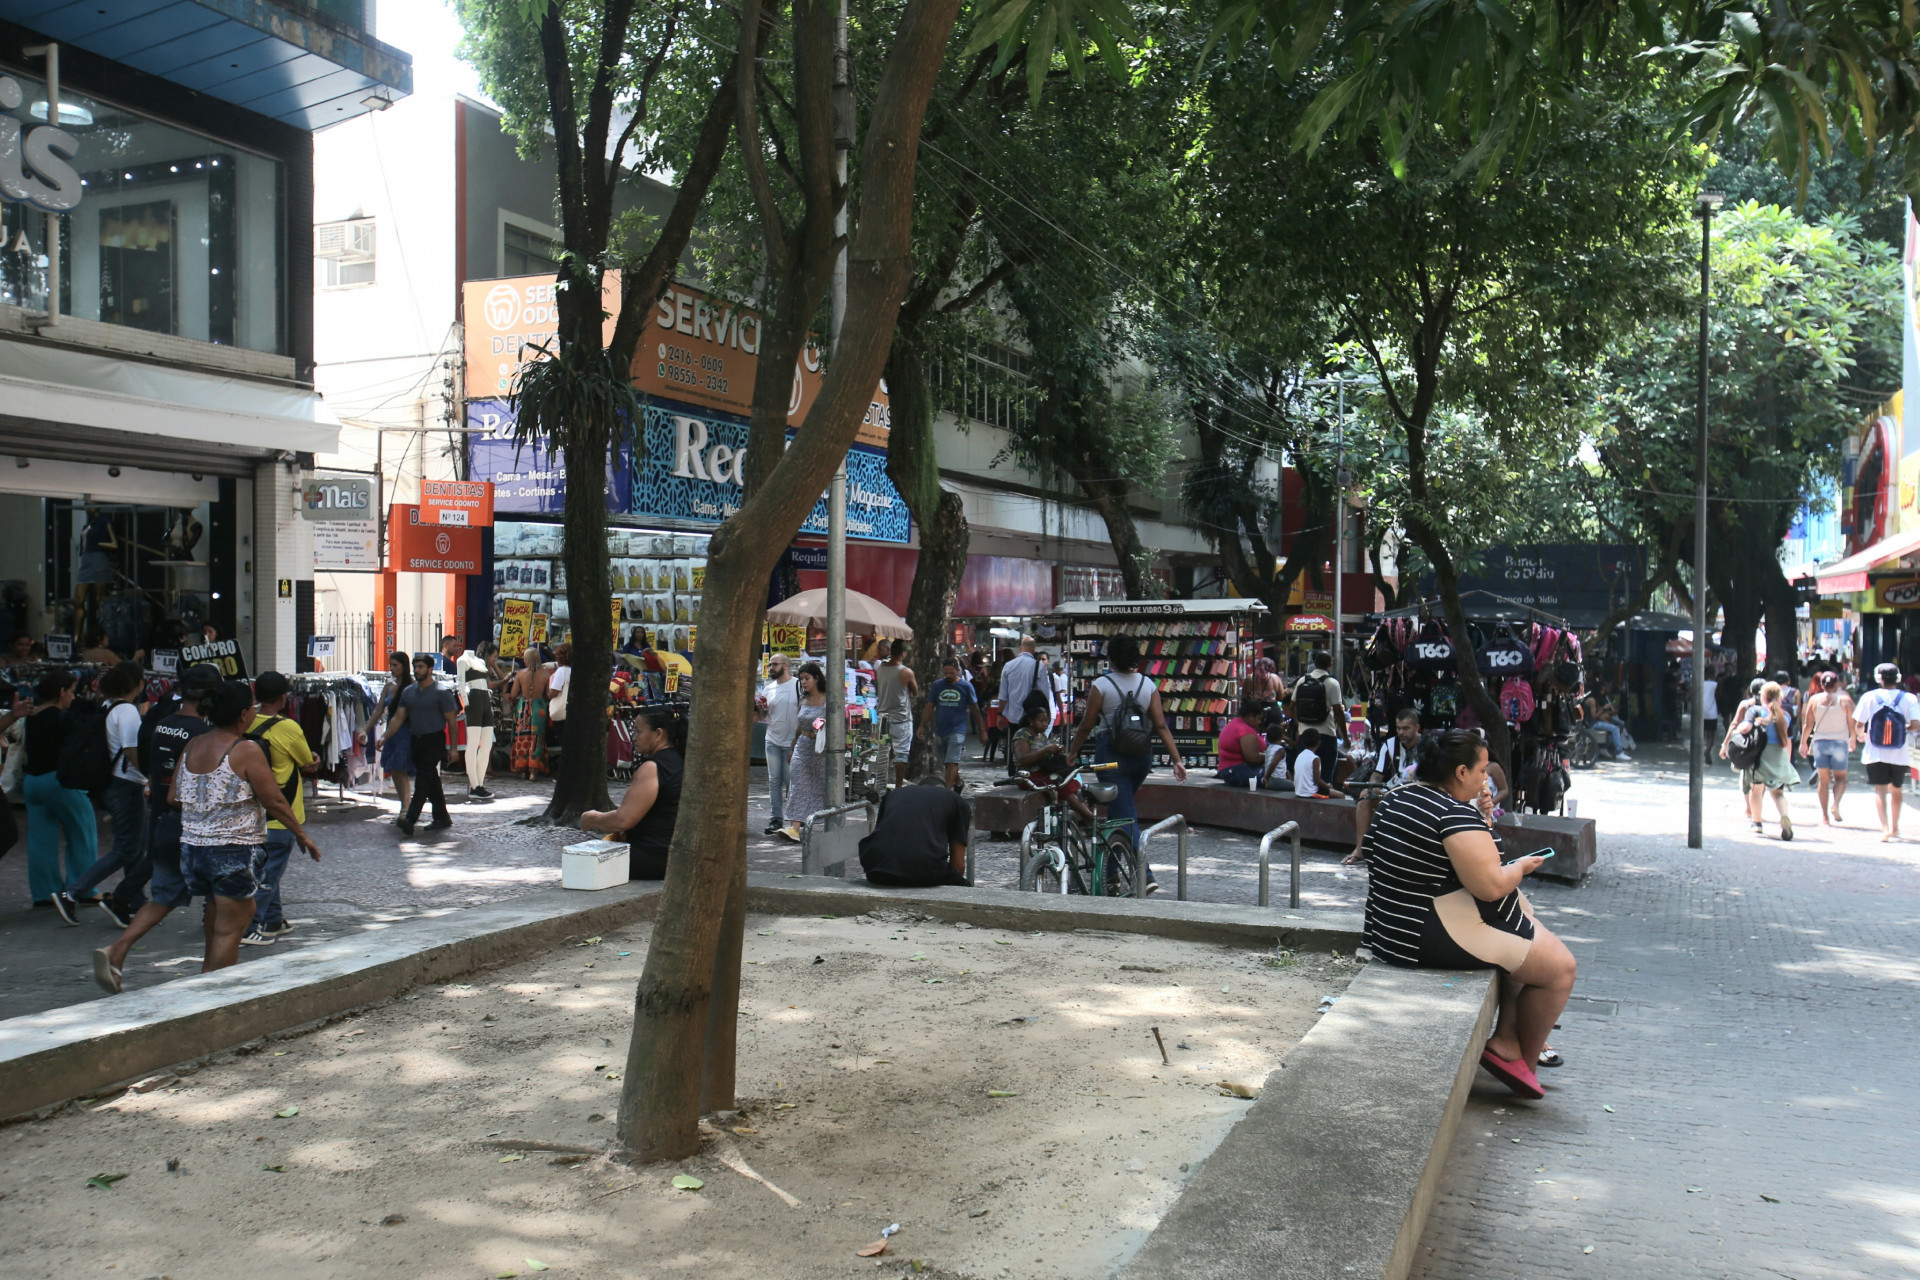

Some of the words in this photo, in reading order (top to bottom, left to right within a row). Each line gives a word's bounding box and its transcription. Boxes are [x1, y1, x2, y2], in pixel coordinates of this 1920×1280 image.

[657, 289, 762, 355] SERVIC
[492, 332, 560, 355] DENTIS
[668, 345, 692, 365] 2416
[701, 355, 723, 374] 0609
[668, 365, 697, 386] 98556
[706, 375, 729, 394] 2342
[496, 471, 521, 481] Cama
[528, 469, 551, 480] Mesa
[424, 482, 484, 497] DENTISTAS
[518, 486, 556, 498] Cortinas
[454, 500, 480, 508] ODONTO
[693, 499, 717, 515] Cama
[453, 513, 465, 522] 124
[410, 558, 442, 568] SERVICE
[444, 560, 475, 570] ODONTO
[791, 551, 827, 564] Requin
[1101, 605, 1132, 614] PELÍCULA
[1133, 606, 1141, 614] DE
[1142, 606, 1162, 614] VIDRO
[1304, 601, 1332, 610] OURO
[182, 640, 236, 661] COMPRO
[1415, 643, 1450, 659] T60
[1486, 650, 1523, 667] T60
